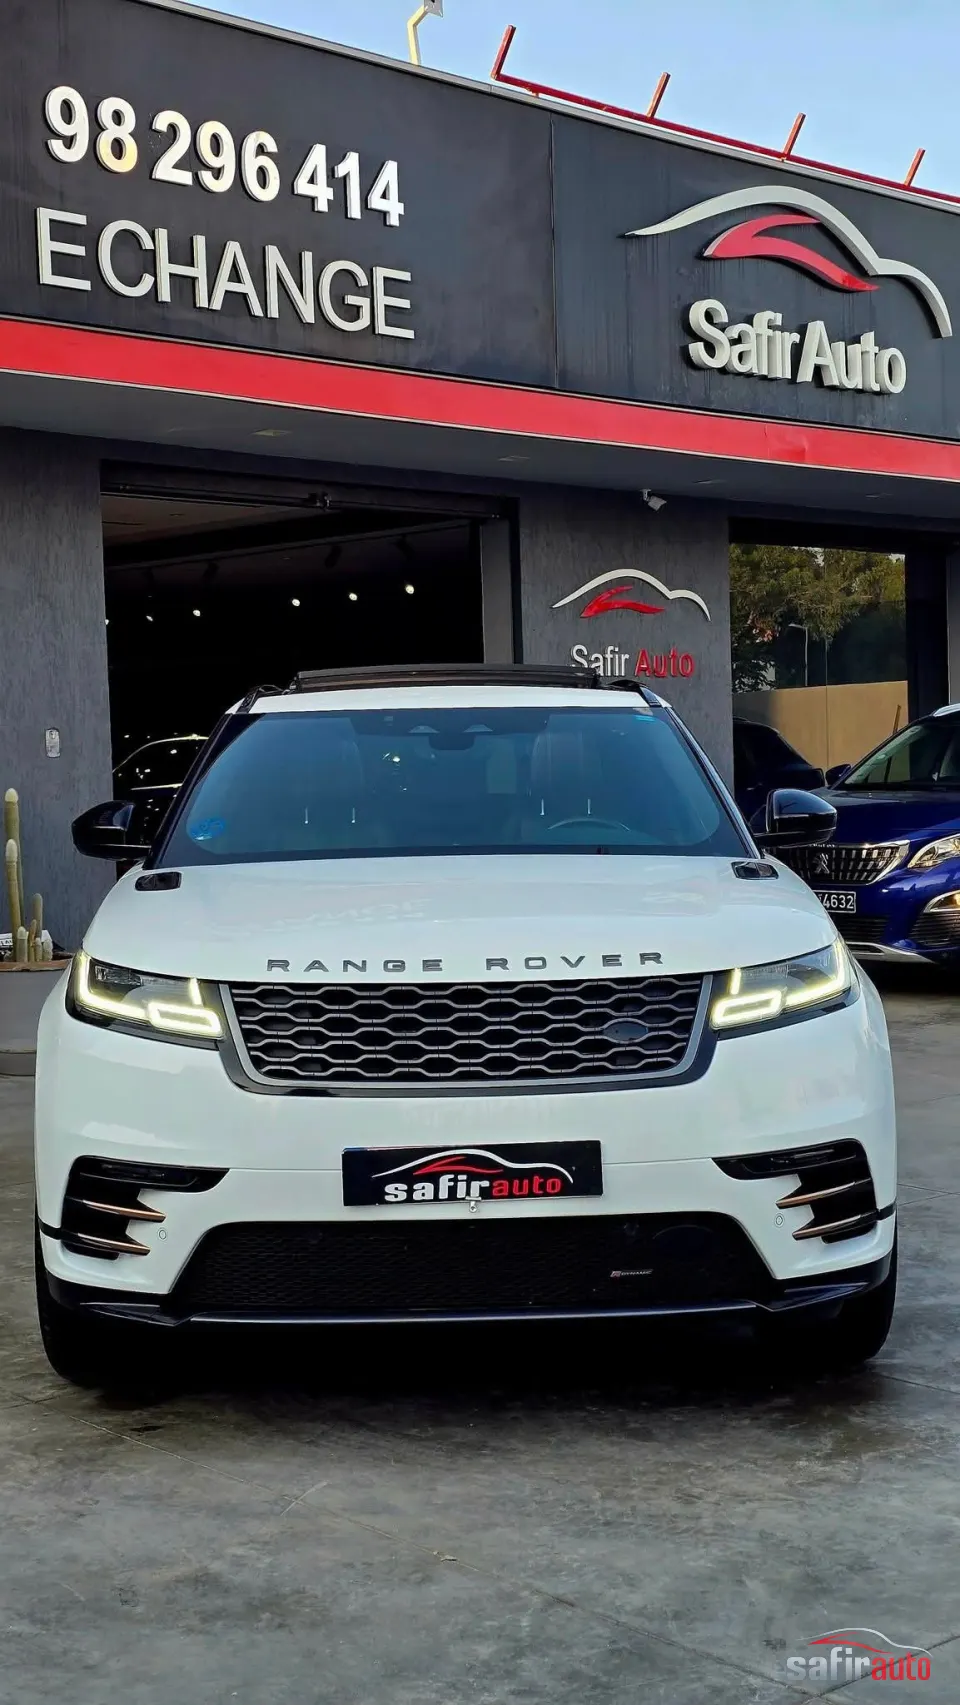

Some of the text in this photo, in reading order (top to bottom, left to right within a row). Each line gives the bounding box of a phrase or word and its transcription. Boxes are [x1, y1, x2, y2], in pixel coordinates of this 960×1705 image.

[45, 86, 405, 226] 98 296 414
[36, 207, 415, 339] ECHANGE
[570, 644, 695, 678] Safir Auto
[267, 952, 663, 973] RANGE ROVER
